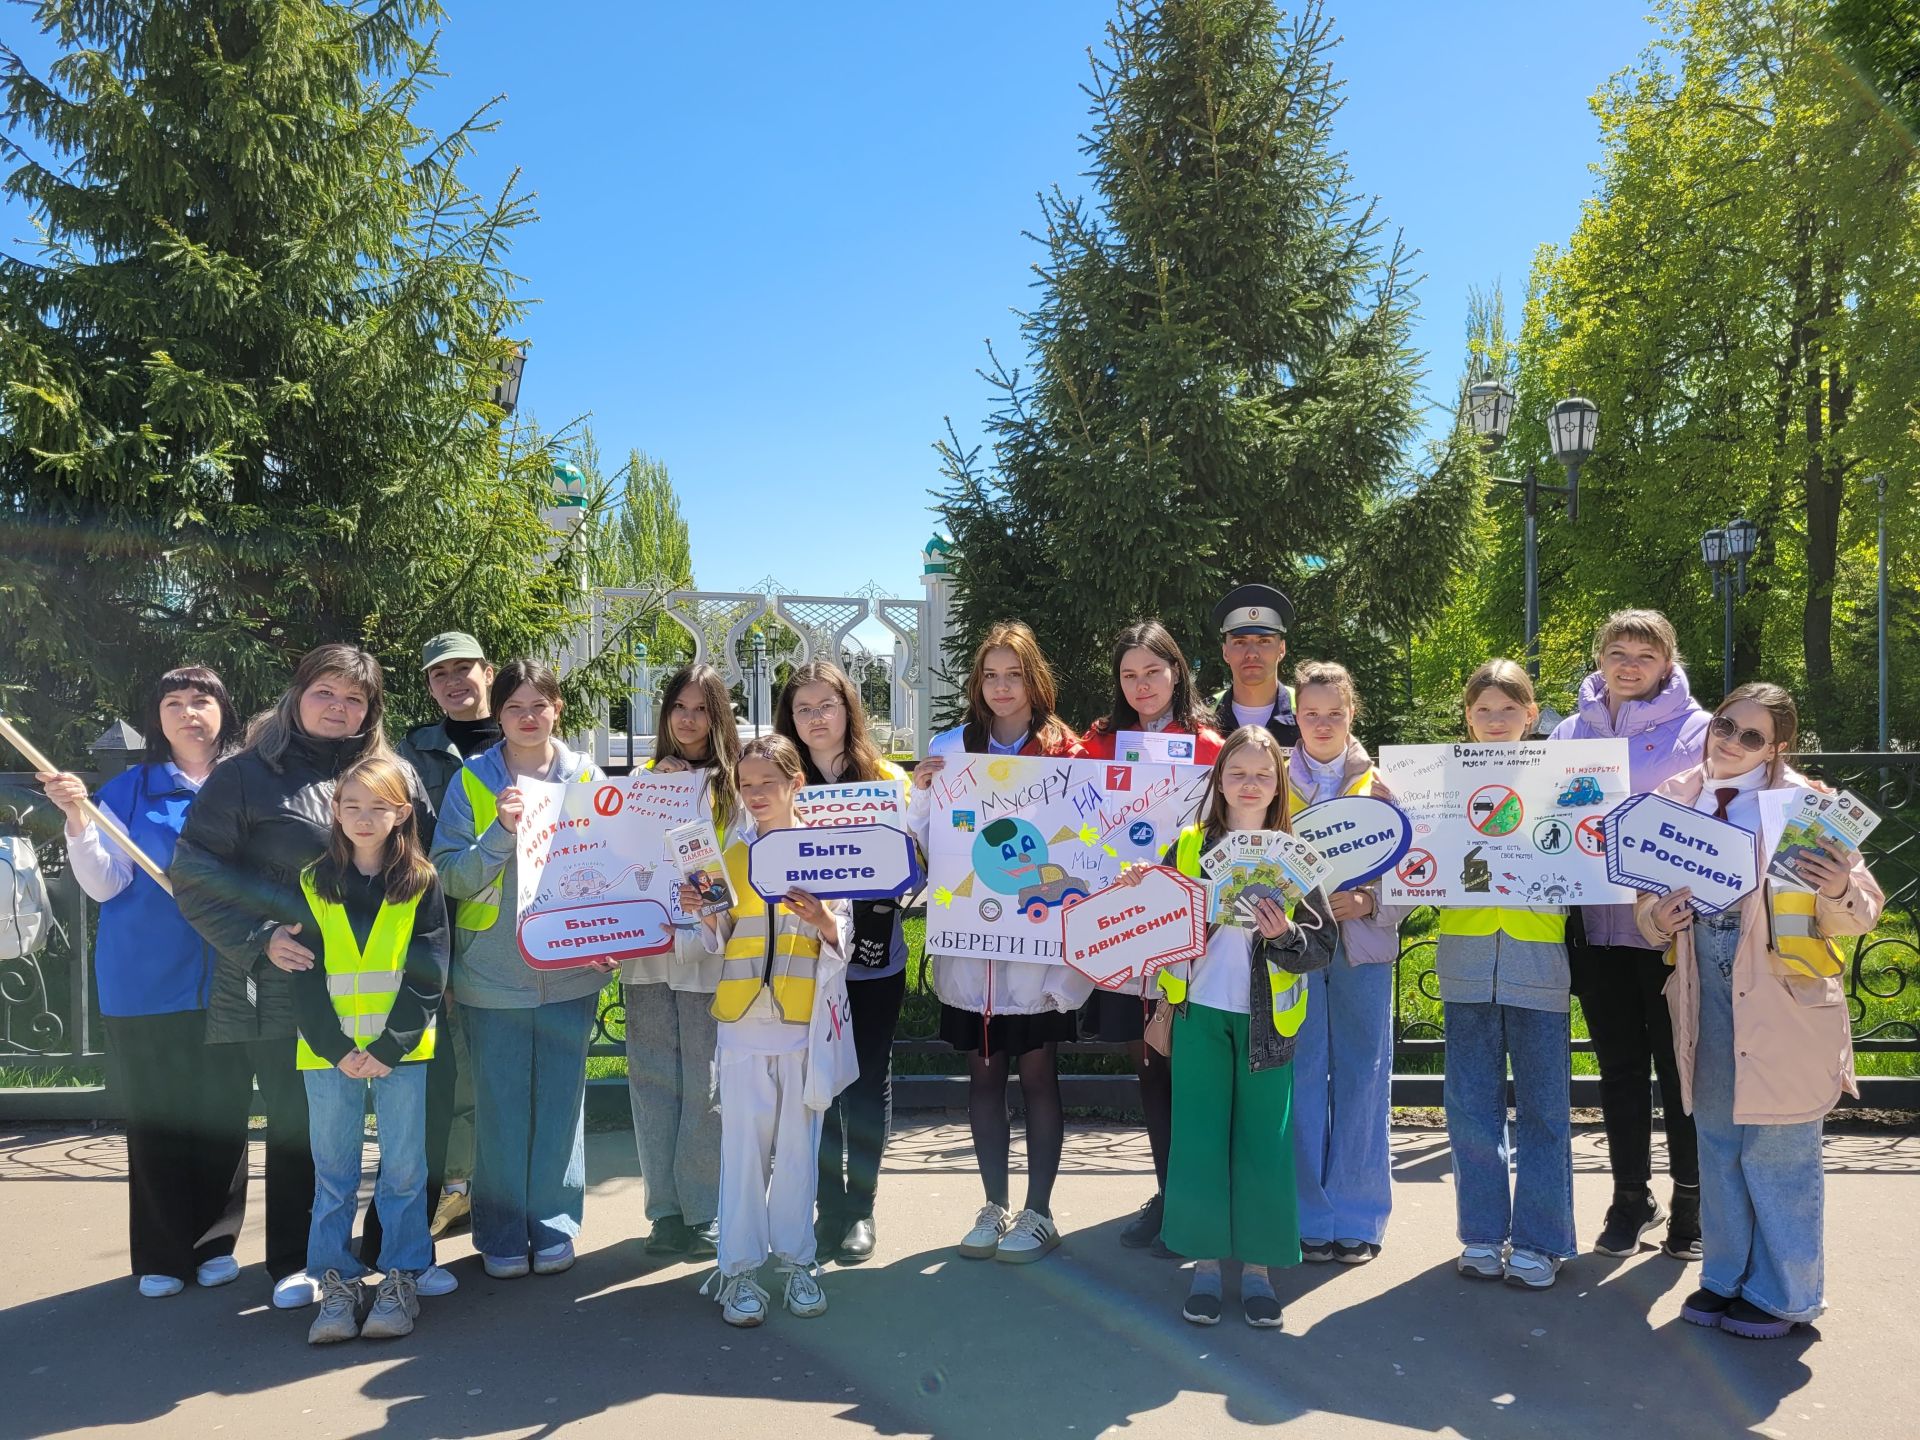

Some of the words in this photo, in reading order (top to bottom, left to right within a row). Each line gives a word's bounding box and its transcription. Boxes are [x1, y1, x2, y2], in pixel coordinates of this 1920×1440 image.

[794, 788, 897, 802] ДИТЕЛЬ!
[802, 816, 876, 827] УСОР!
[1299, 821, 1356, 843] Быть
[1830, 808, 1864, 837] ПАМЯТКА
[798, 842, 861, 857] Быть
[1658, 822, 1719, 857] Быть
[682, 847, 714, 863] ПАМЯТКА
[1240, 847, 1266, 856] ПАМЯТ
[786, 866, 875, 881] вместе
[1289, 853, 1316, 881] ПАМЯТКА
[1622, 836, 1636, 848] с
[1640, 841, 1743, 891] Россией
[564, 916, 619, 930] Быть
[1097, 904, 1146, 930] Быть
[547, 928, 645, 949] первыми
[929, 930, 1024, 955] «БЕРЕГИ
[1074, 949, 1084, 960] в
[1088, 906, 1188, 957] движении
